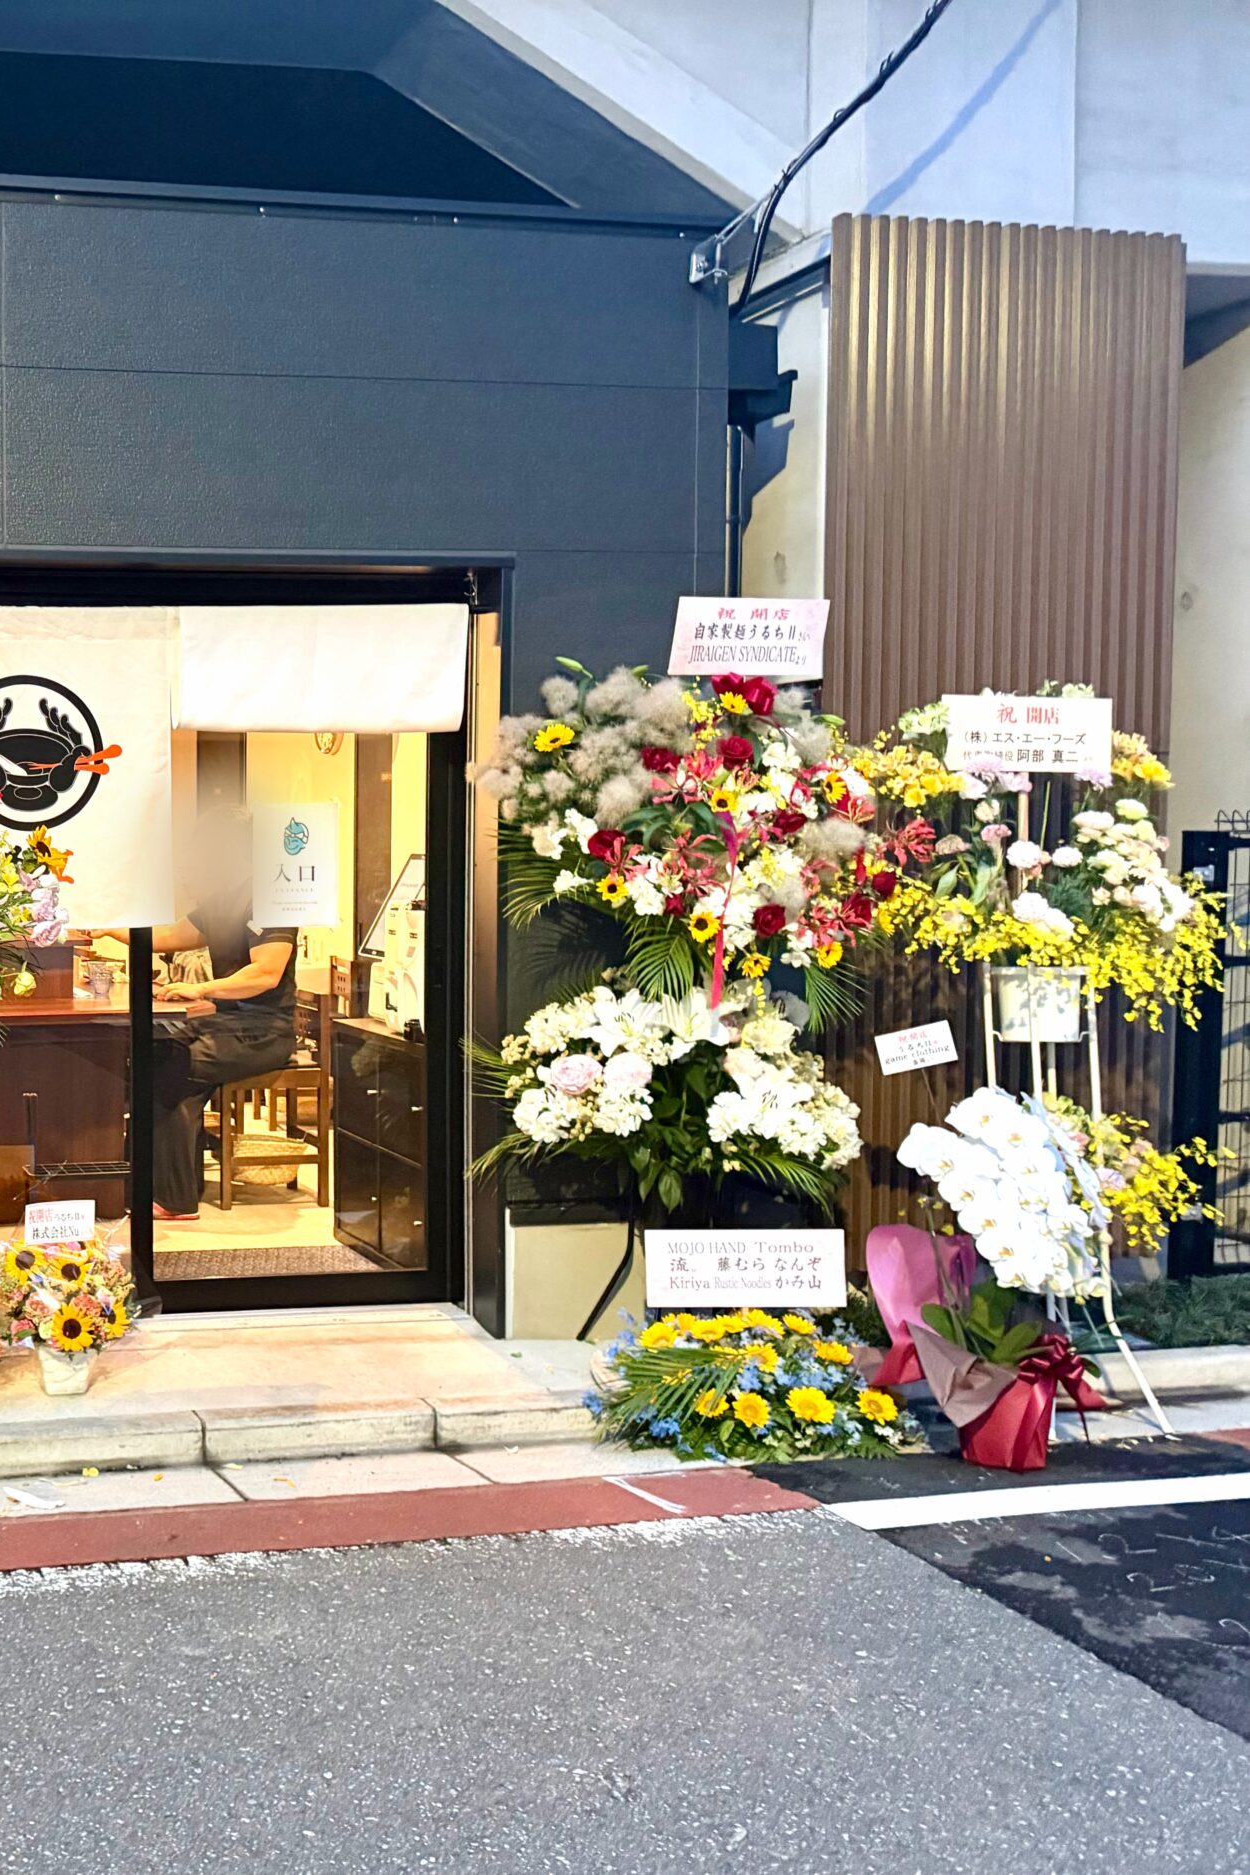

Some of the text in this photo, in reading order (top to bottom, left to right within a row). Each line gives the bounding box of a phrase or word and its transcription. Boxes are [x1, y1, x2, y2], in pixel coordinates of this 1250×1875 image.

[688, 645, 737, 664] JIRAIGEN
[738, 645, 797, 663] SYNDICATE
[273, 863, 315, 882] 入口
[754, 1241, 814, 1253] Tombo
[670, 1275, 710, 1291] Kiriya
